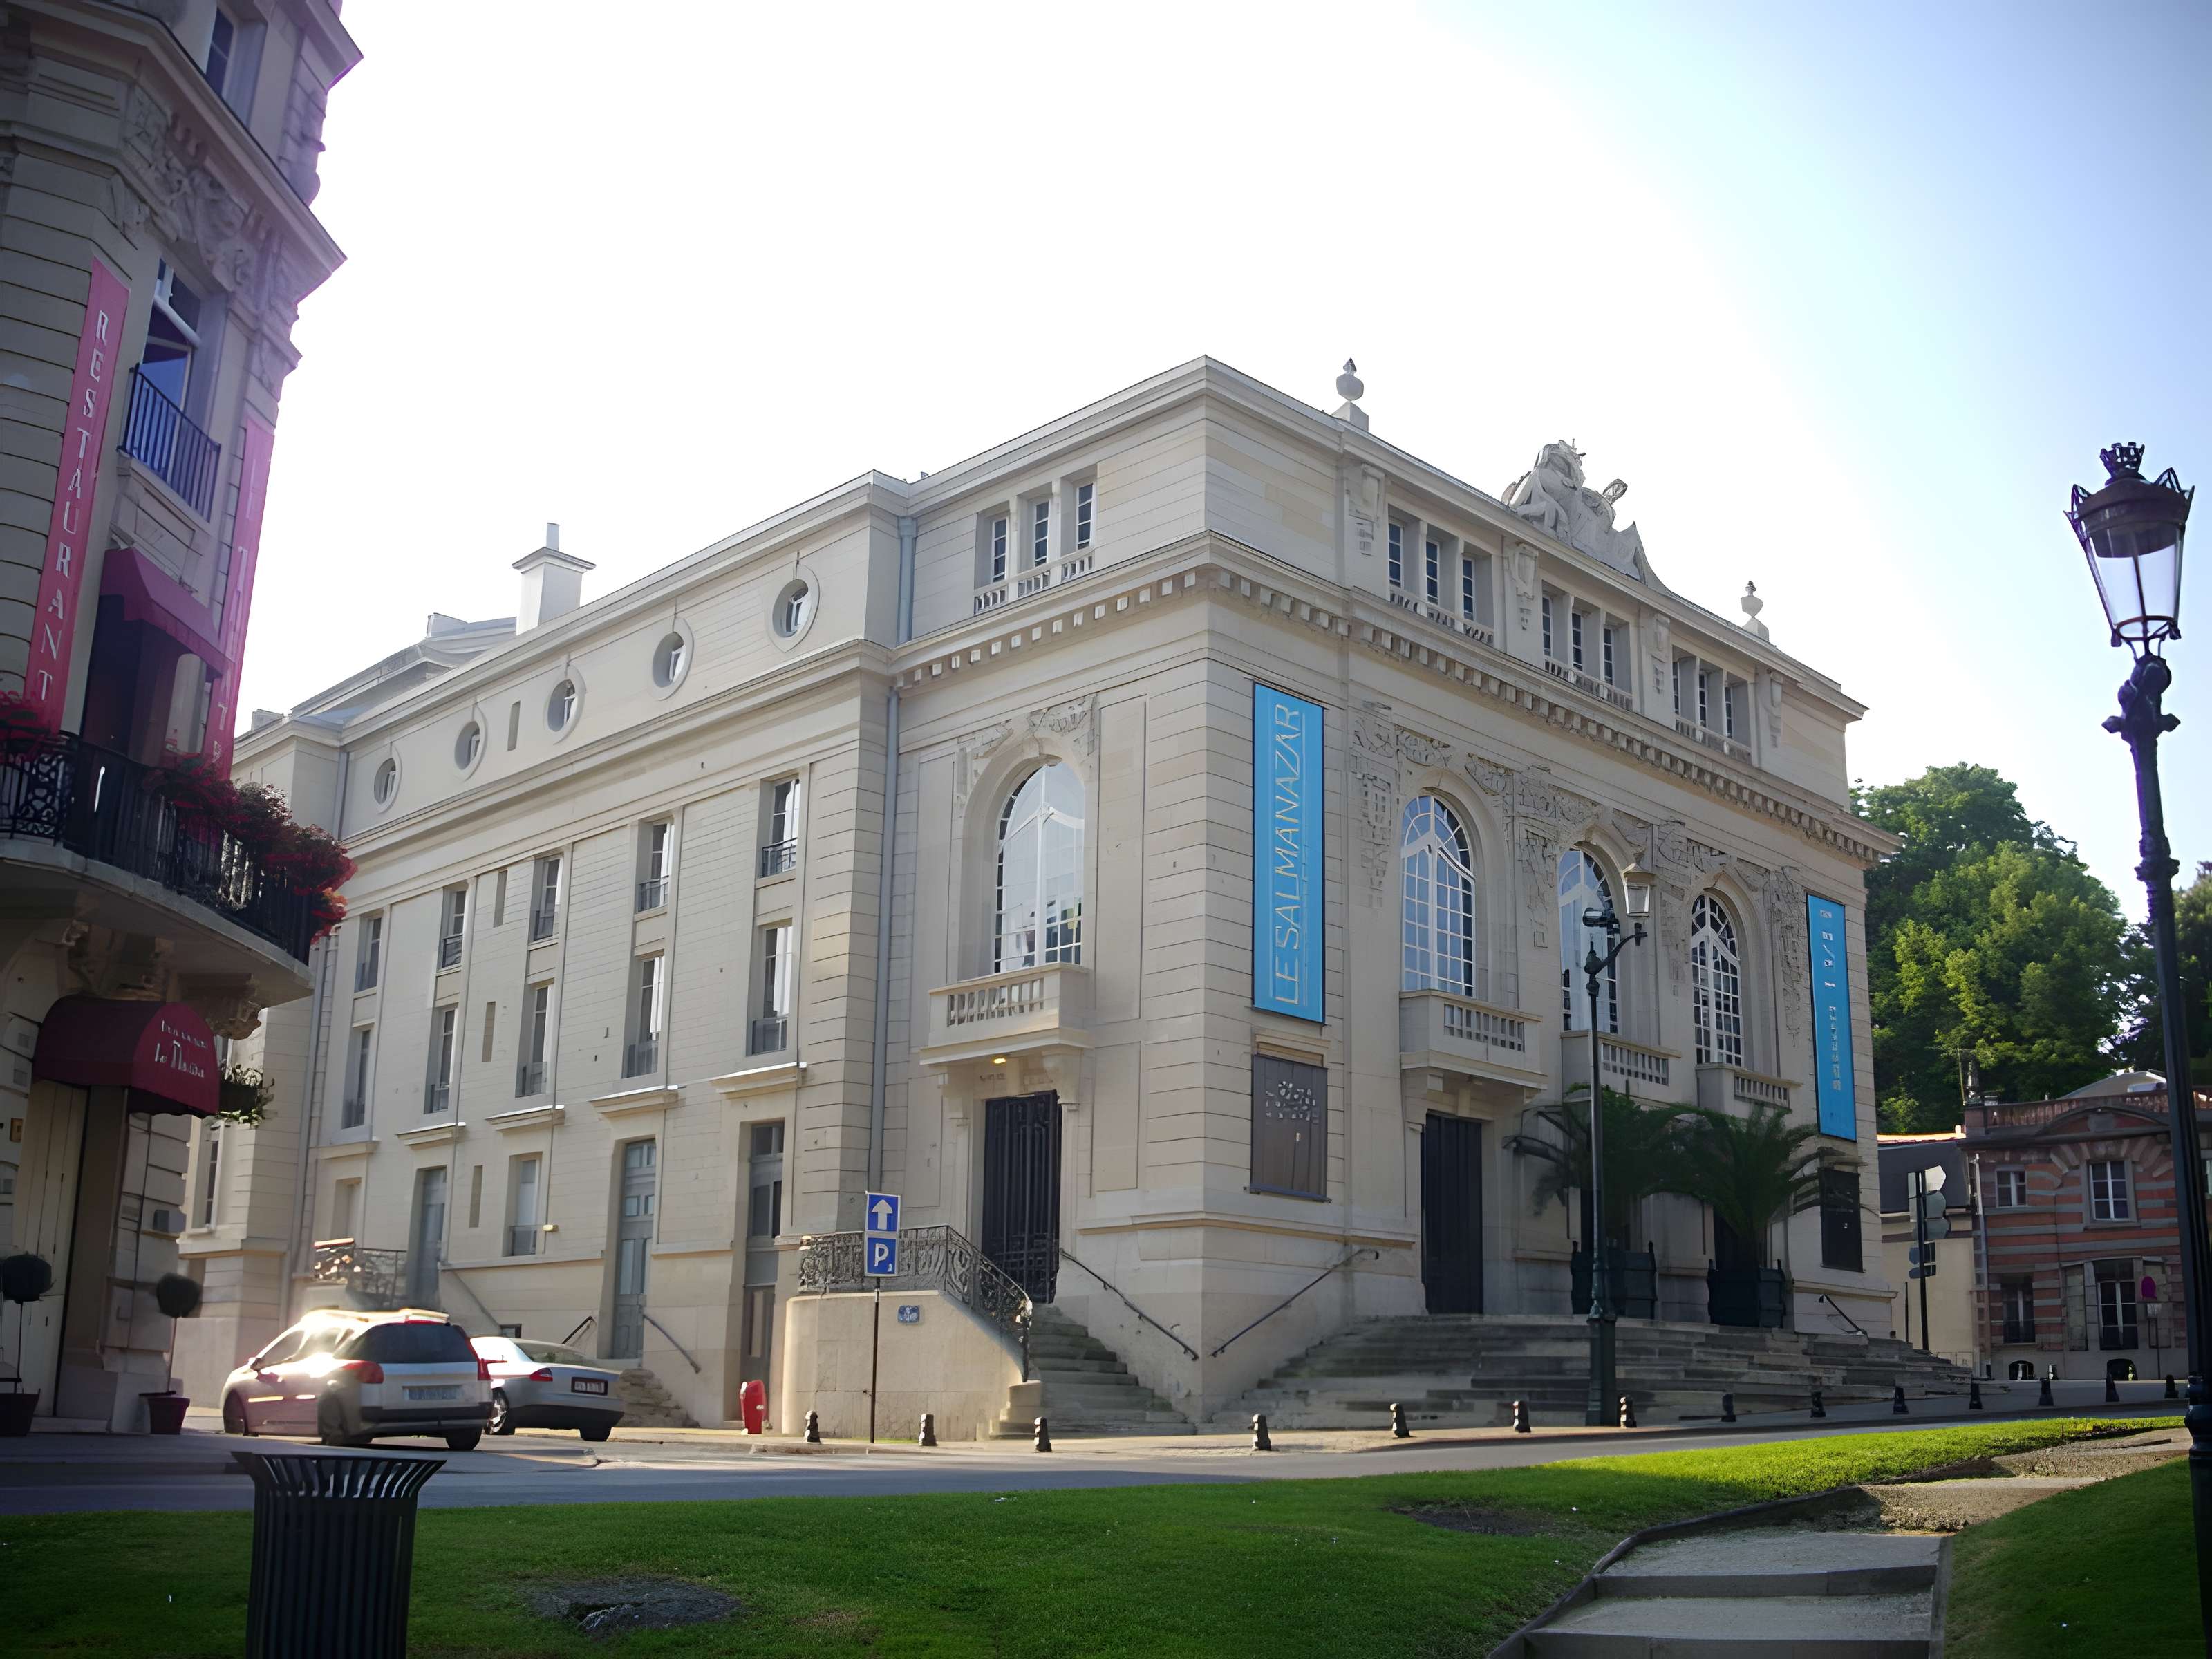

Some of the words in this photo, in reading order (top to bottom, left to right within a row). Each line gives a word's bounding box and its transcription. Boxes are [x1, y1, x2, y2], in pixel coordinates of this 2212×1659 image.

[38, 309, 109, 701] RESTAURANT
[1275, 703, 1301, 950] SALMANAZAR
[1275, 954, 1299, 1005] LE
[874, 1243, 889, 1267] P
